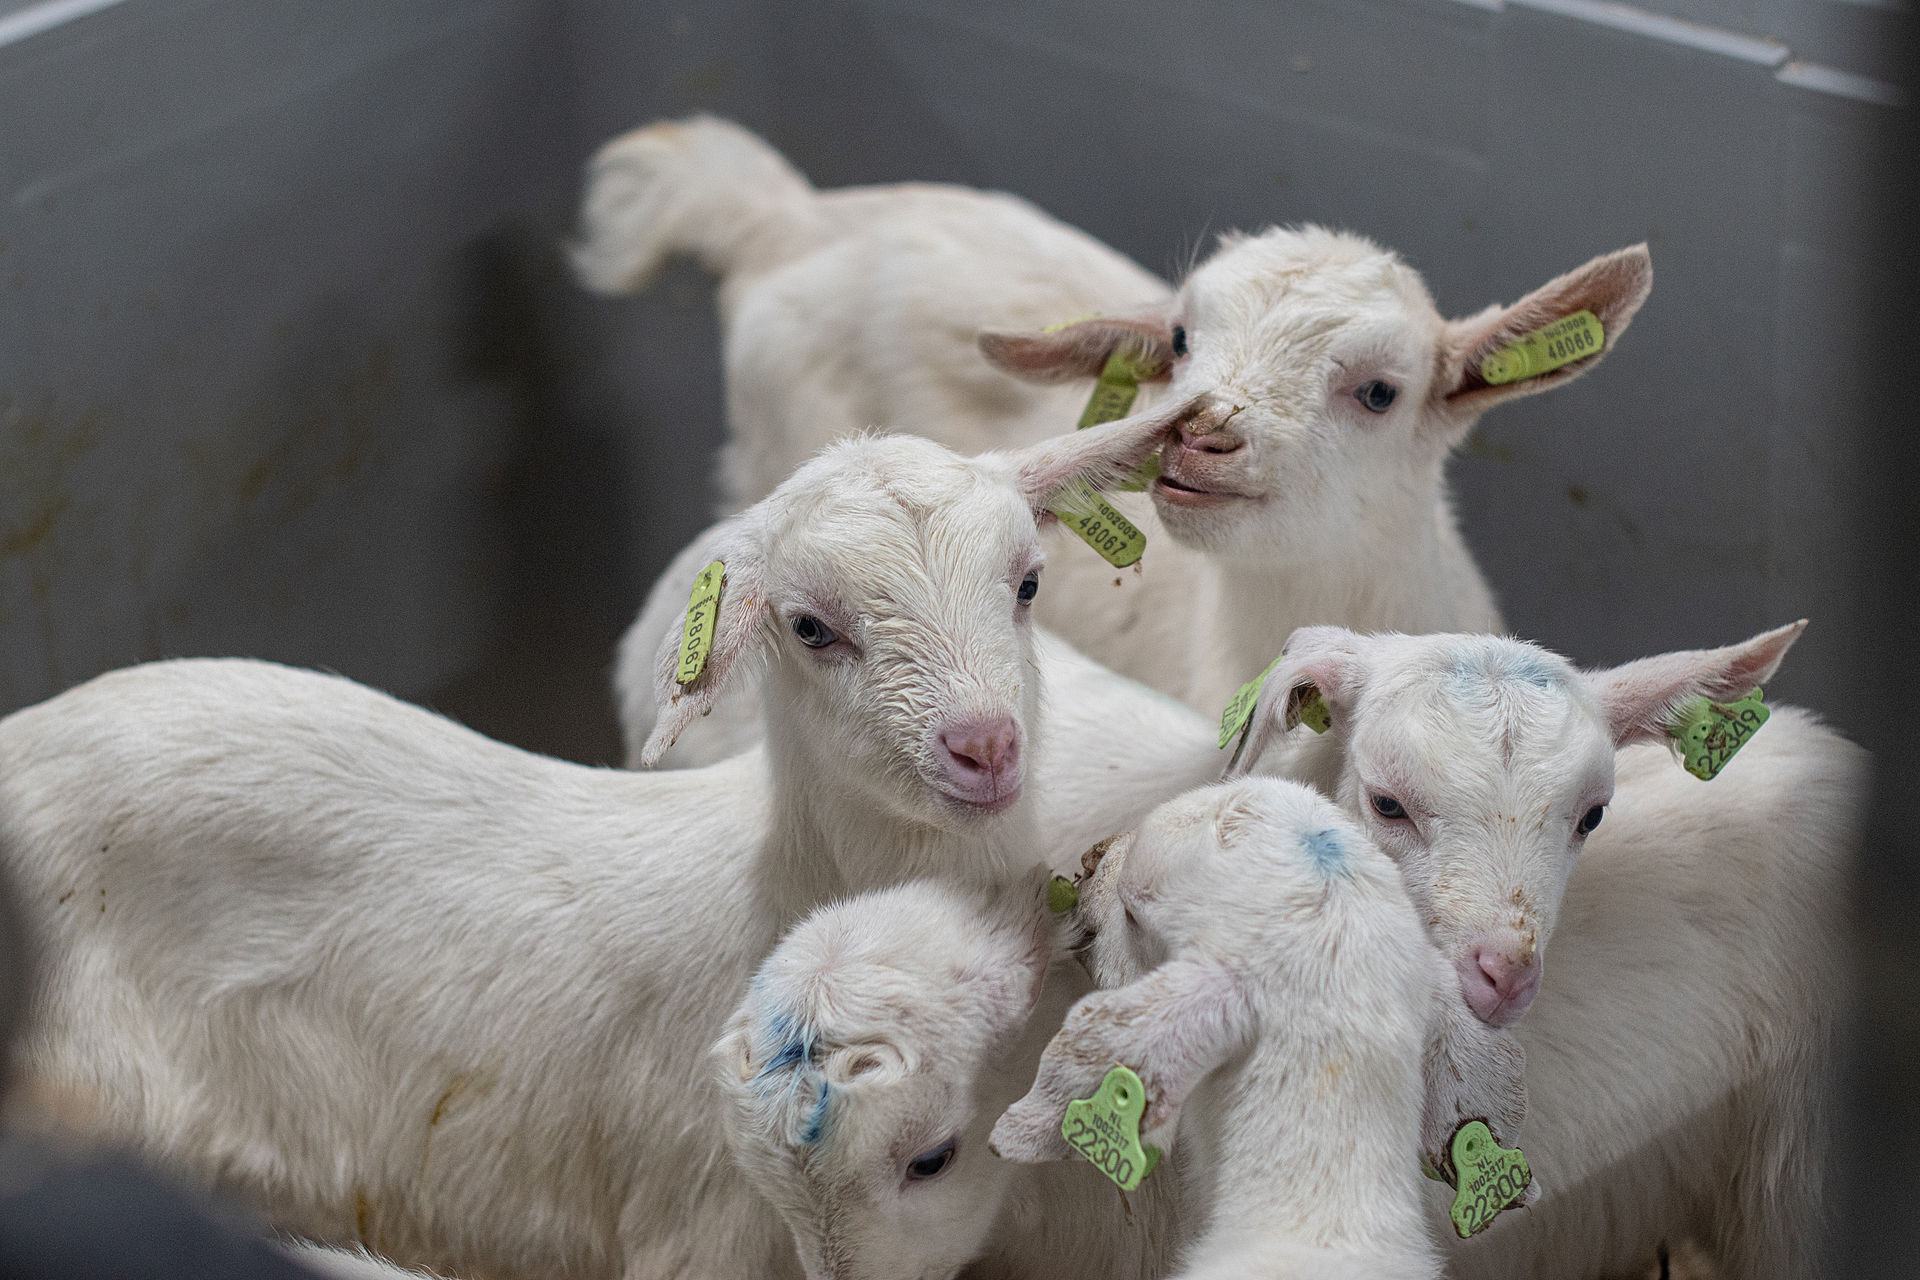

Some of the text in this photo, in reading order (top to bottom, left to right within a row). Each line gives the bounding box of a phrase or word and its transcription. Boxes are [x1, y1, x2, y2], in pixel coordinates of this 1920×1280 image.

[1080, 515, 1127, 556] 48067
[1098, 503, 1137, 540] 1002003
[683, 611, 704, 676] 48067
[1092, 1113, 1129, 1150] 1002317
[1109, 1110, 1121, 1131] NL
[1067, 1117, 1133, 1184] 22300
[1477, 1155, 1492, 1172] NL
[1469, 1157, 1505, 1195] 1002317
[1463, 1164, 1524, 1233] 22300
